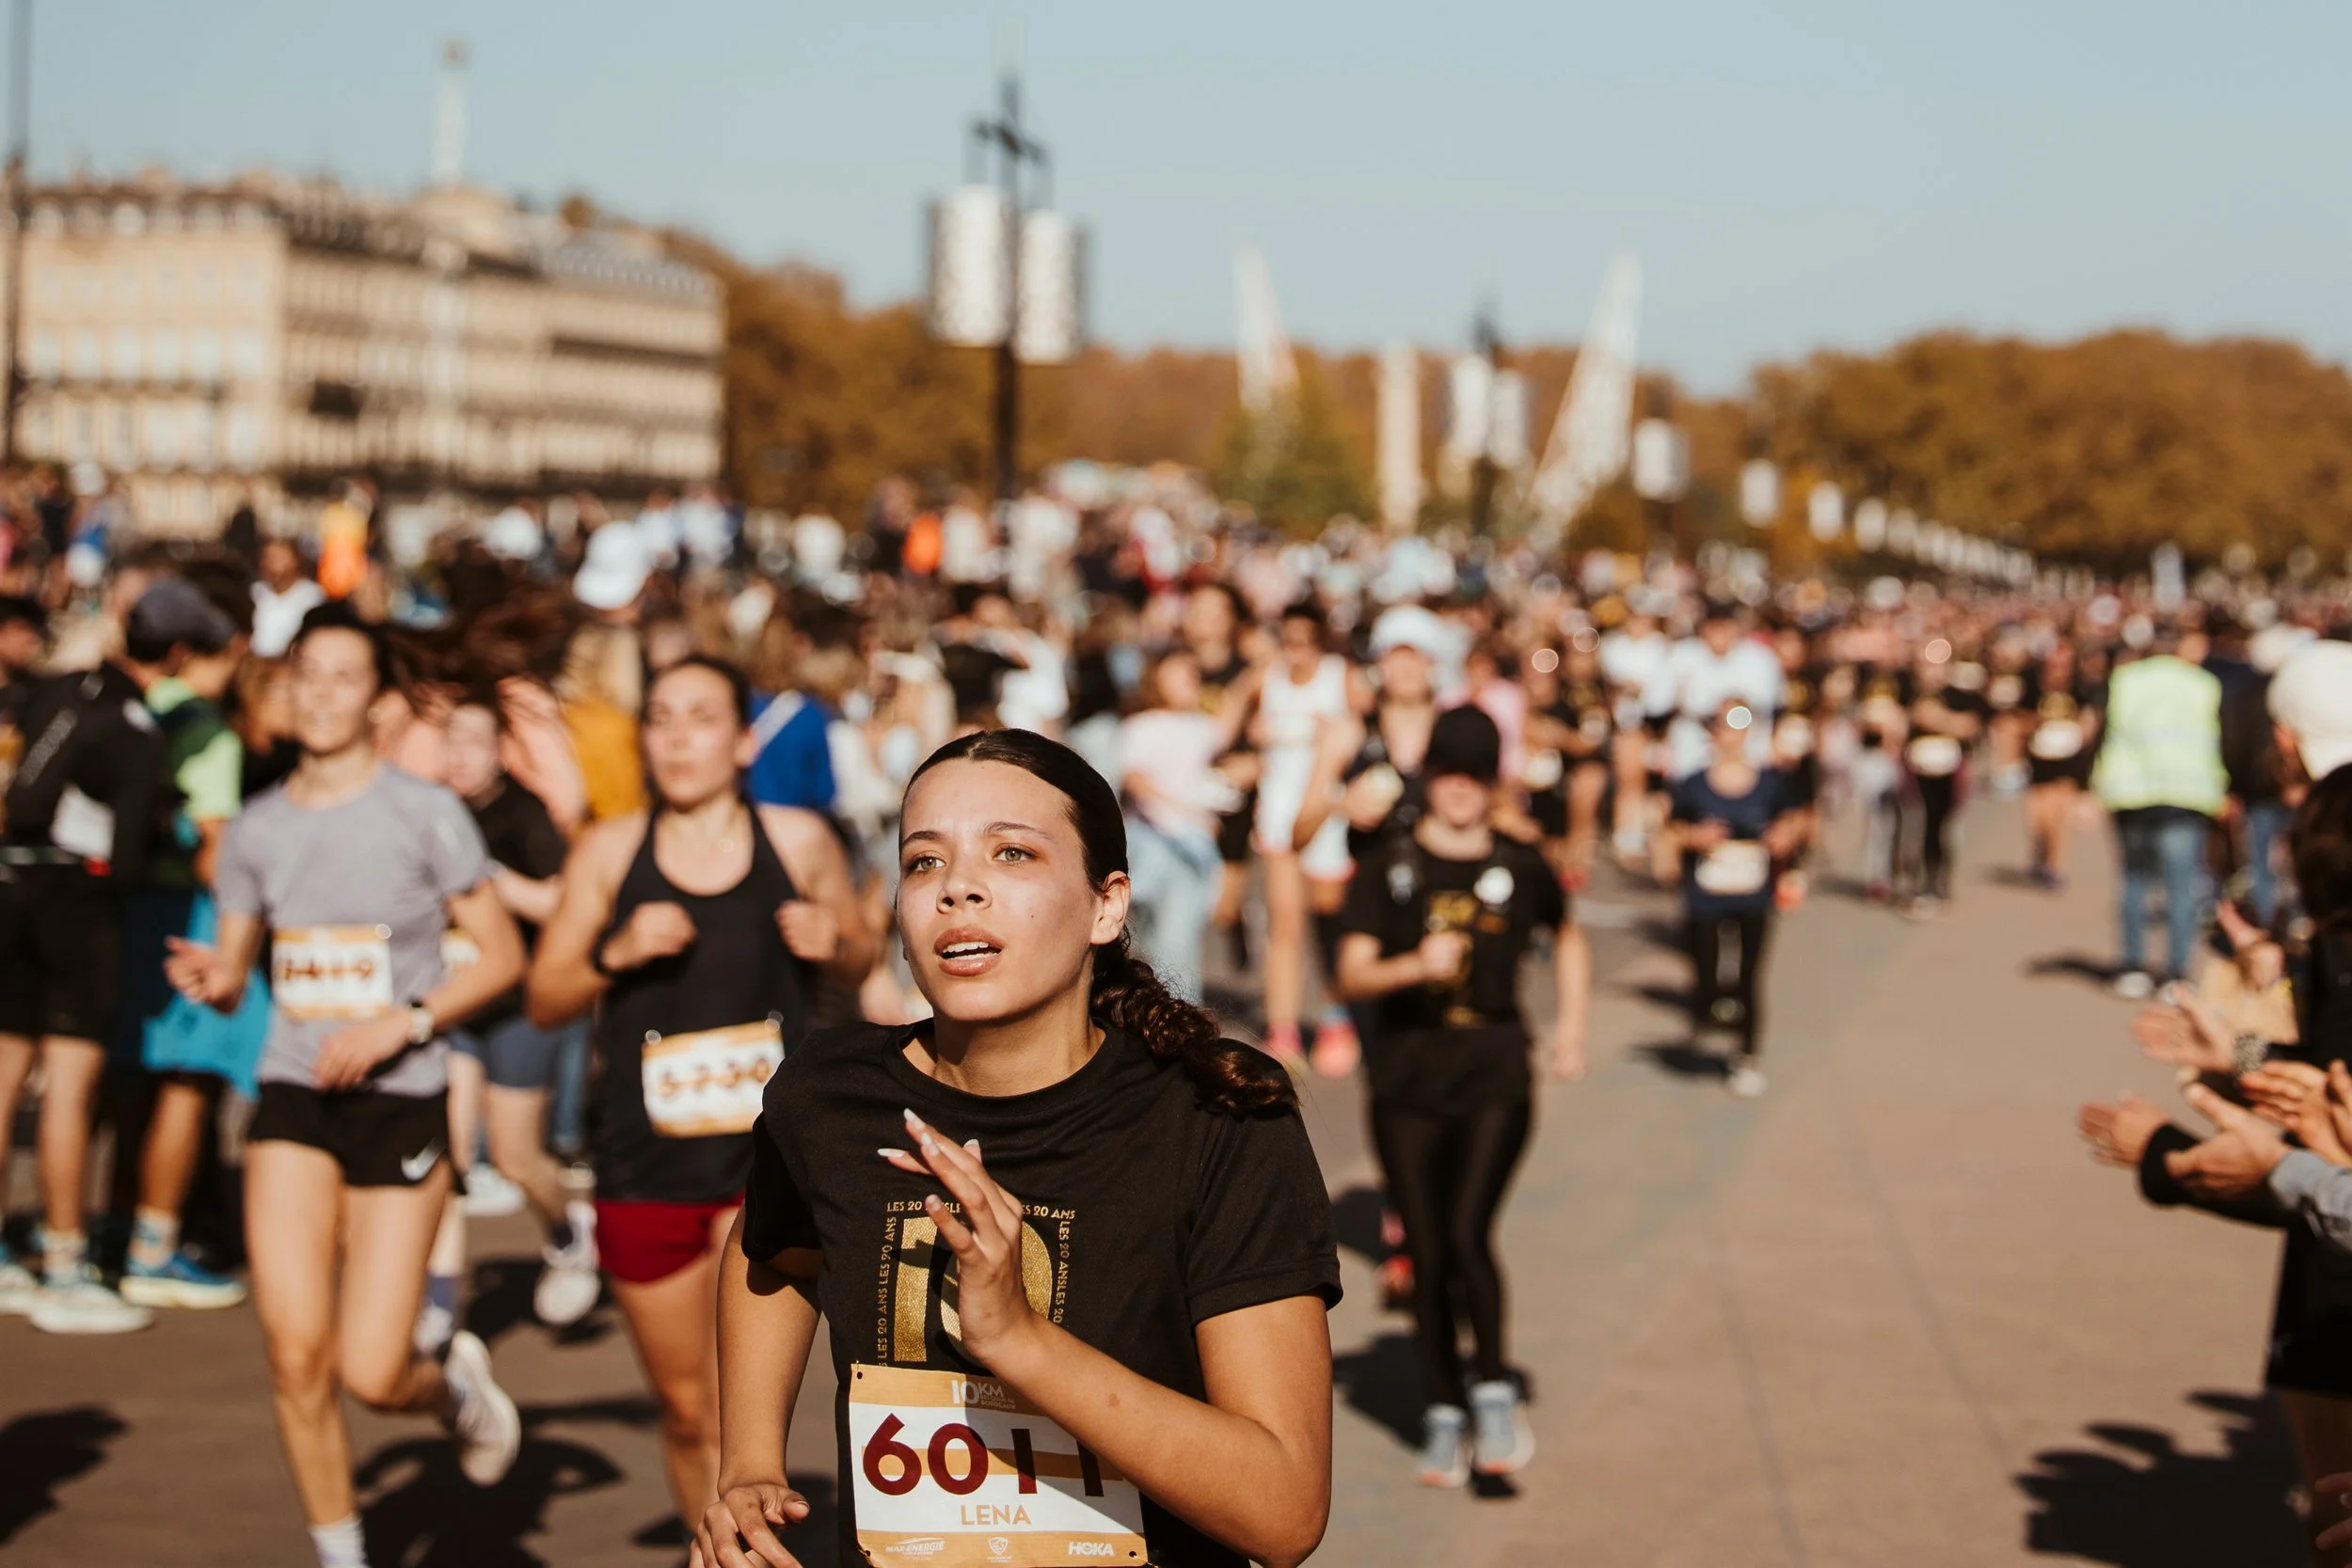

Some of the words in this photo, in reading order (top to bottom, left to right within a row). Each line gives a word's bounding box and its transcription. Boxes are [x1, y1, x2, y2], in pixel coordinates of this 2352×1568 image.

[887, 1201, 905, 1212] LES
[907, 1200, 923, 1212] 20
[1033, 1205, 1049, 1217] 20
[1050, 1208, 1076, 1220] ANS
[884, 1216, 897, 1242] ANS
[1058, 1220, 1071, 1241] LES
[881, 1244, 893, 1260] 20
[1058, 1243, 1070, 1259] 20
[878, 1263, 890, 1285] LES
[878, 1288, 888, 1314] ANS
[877, 1317, 887, 1335] 20
[1053, 1307, 1064, 1324] 20
[878, 1338, 887, 1359] LES
[863, 1413, 1104, 1497] 6011
[961, 1505, 1032, 1526] LENA
[1068, 1541, 1115, 1556] HOKA
